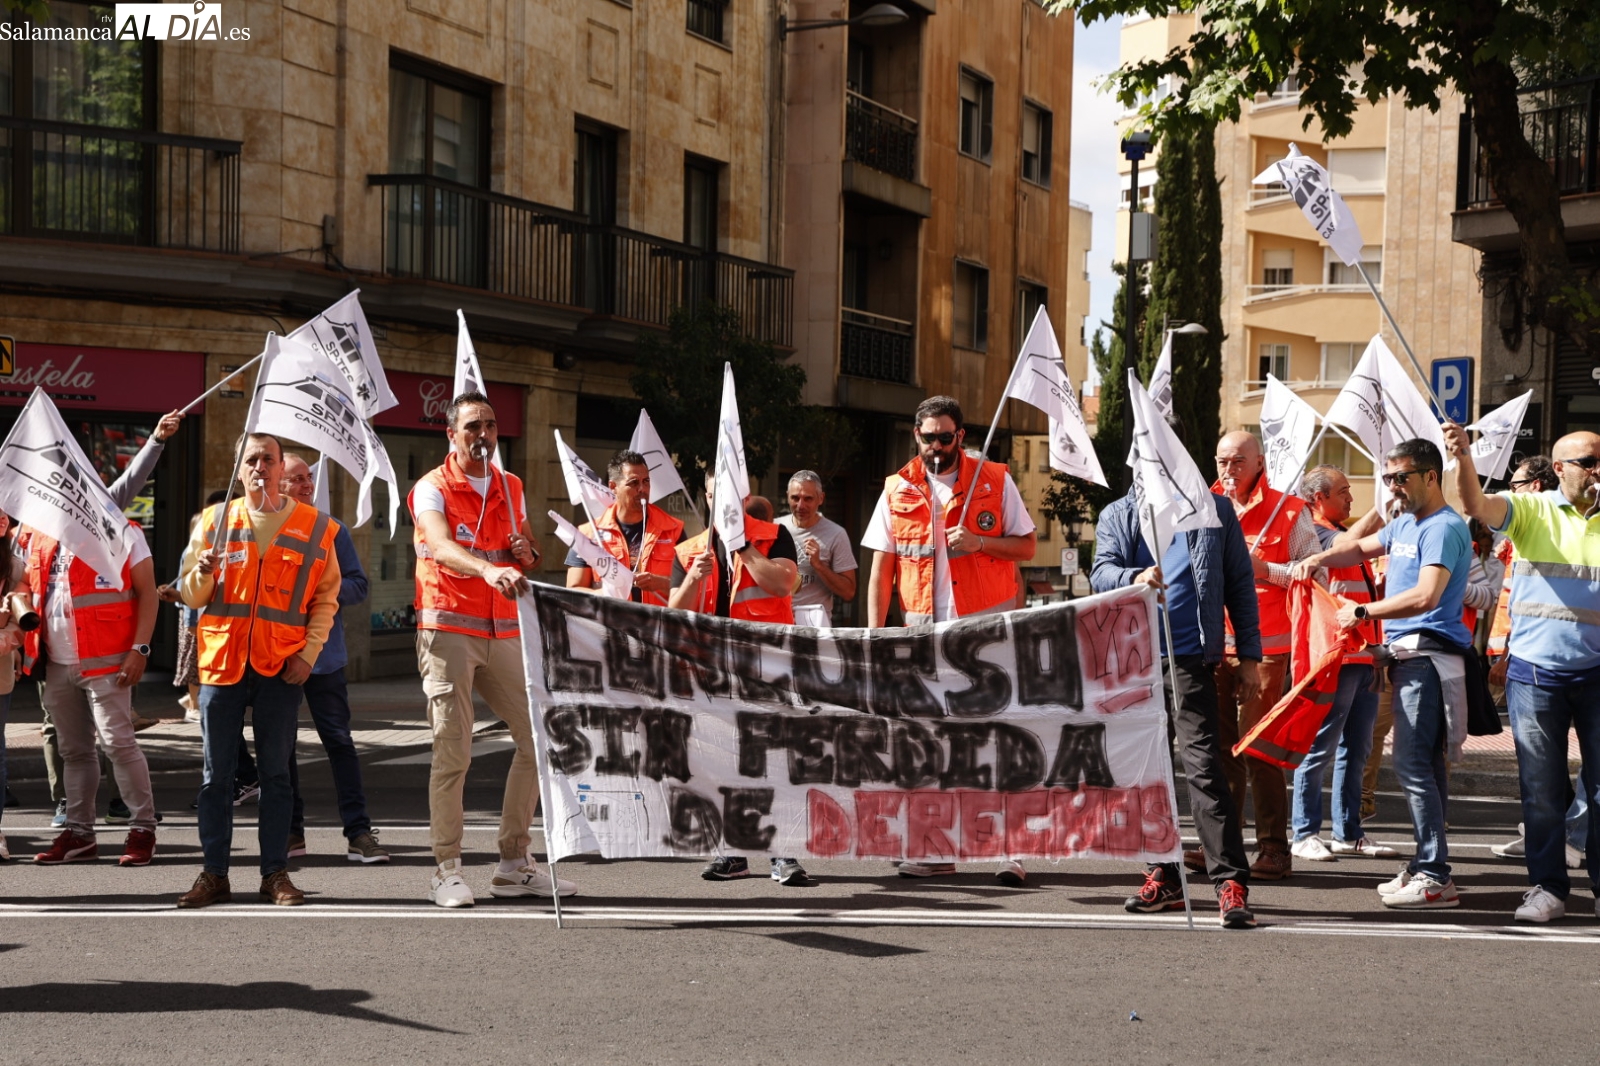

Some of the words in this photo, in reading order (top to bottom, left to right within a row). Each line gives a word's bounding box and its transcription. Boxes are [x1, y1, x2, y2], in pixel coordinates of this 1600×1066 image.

[1438, 365, 1462, 418] P
[294, 412, 345, 445] CASTILLA
[310, 403, 366, 458] SP-TES
[27, 485, 74, 517] CASTILLA
[47, 471, 99, 524] SP-TES
[533, 586, 1084, 718] CONCURSO
[543, 703, 693, 783] SIN
[735, 709, 1116, 790] PERDIDA
[663, 786, 776, 853] DE
[805, 783, 1178, 858] DERECHOS
